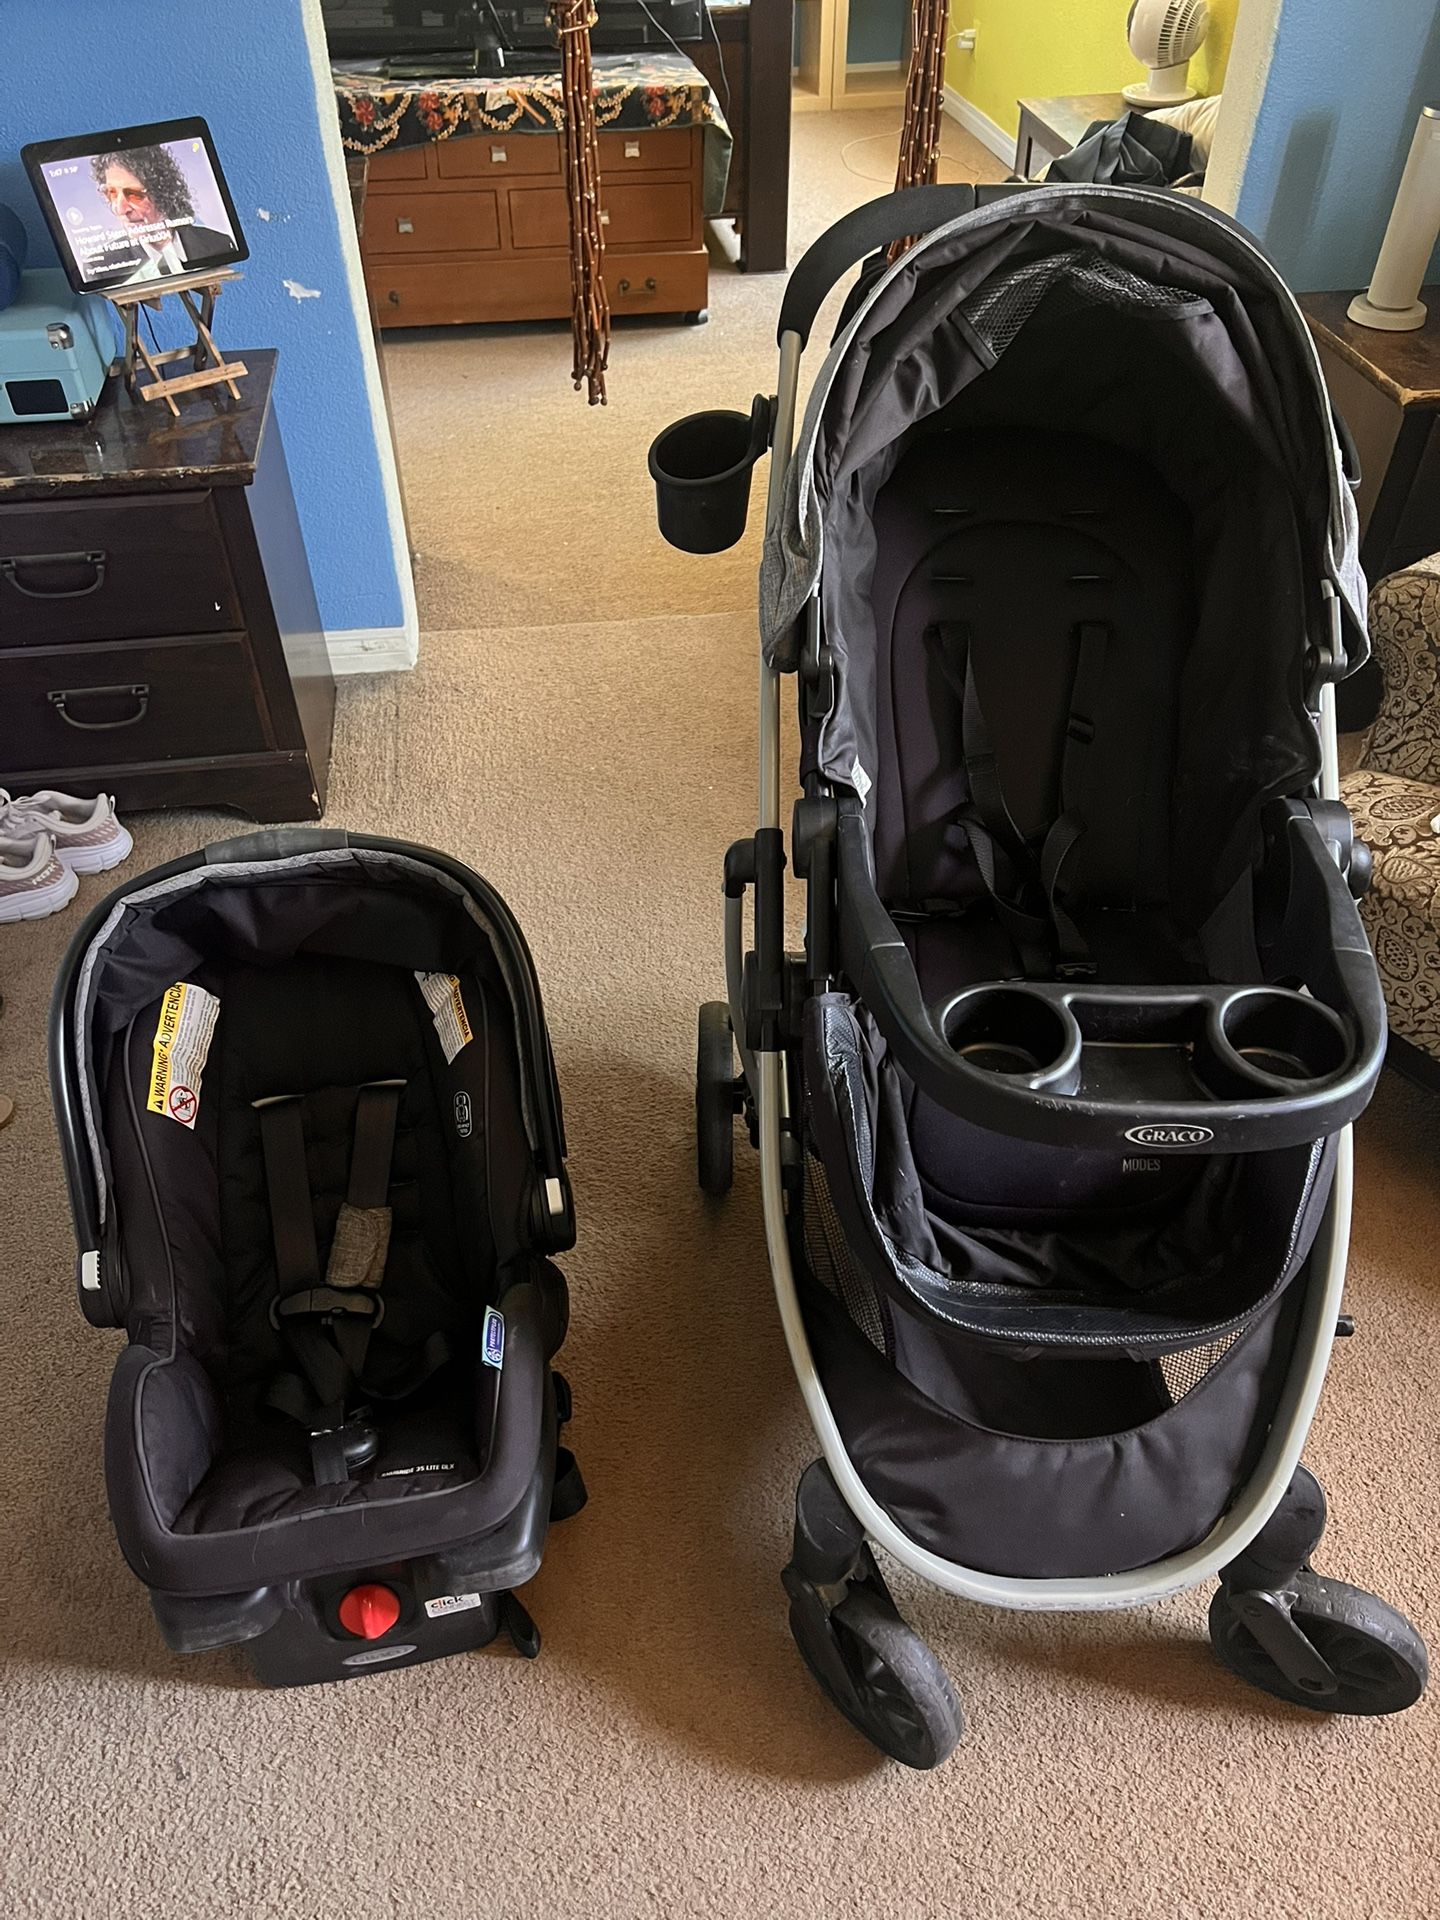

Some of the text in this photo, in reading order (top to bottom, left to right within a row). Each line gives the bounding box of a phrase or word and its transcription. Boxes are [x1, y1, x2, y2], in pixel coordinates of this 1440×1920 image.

[103, 239, 130, 252] Future
[159, 983, 184, 1048] ADVERTENCIA
[1137, 1128, 1205, 1142] GRACO
[1122, 1158, 1161, 1172] MODES
